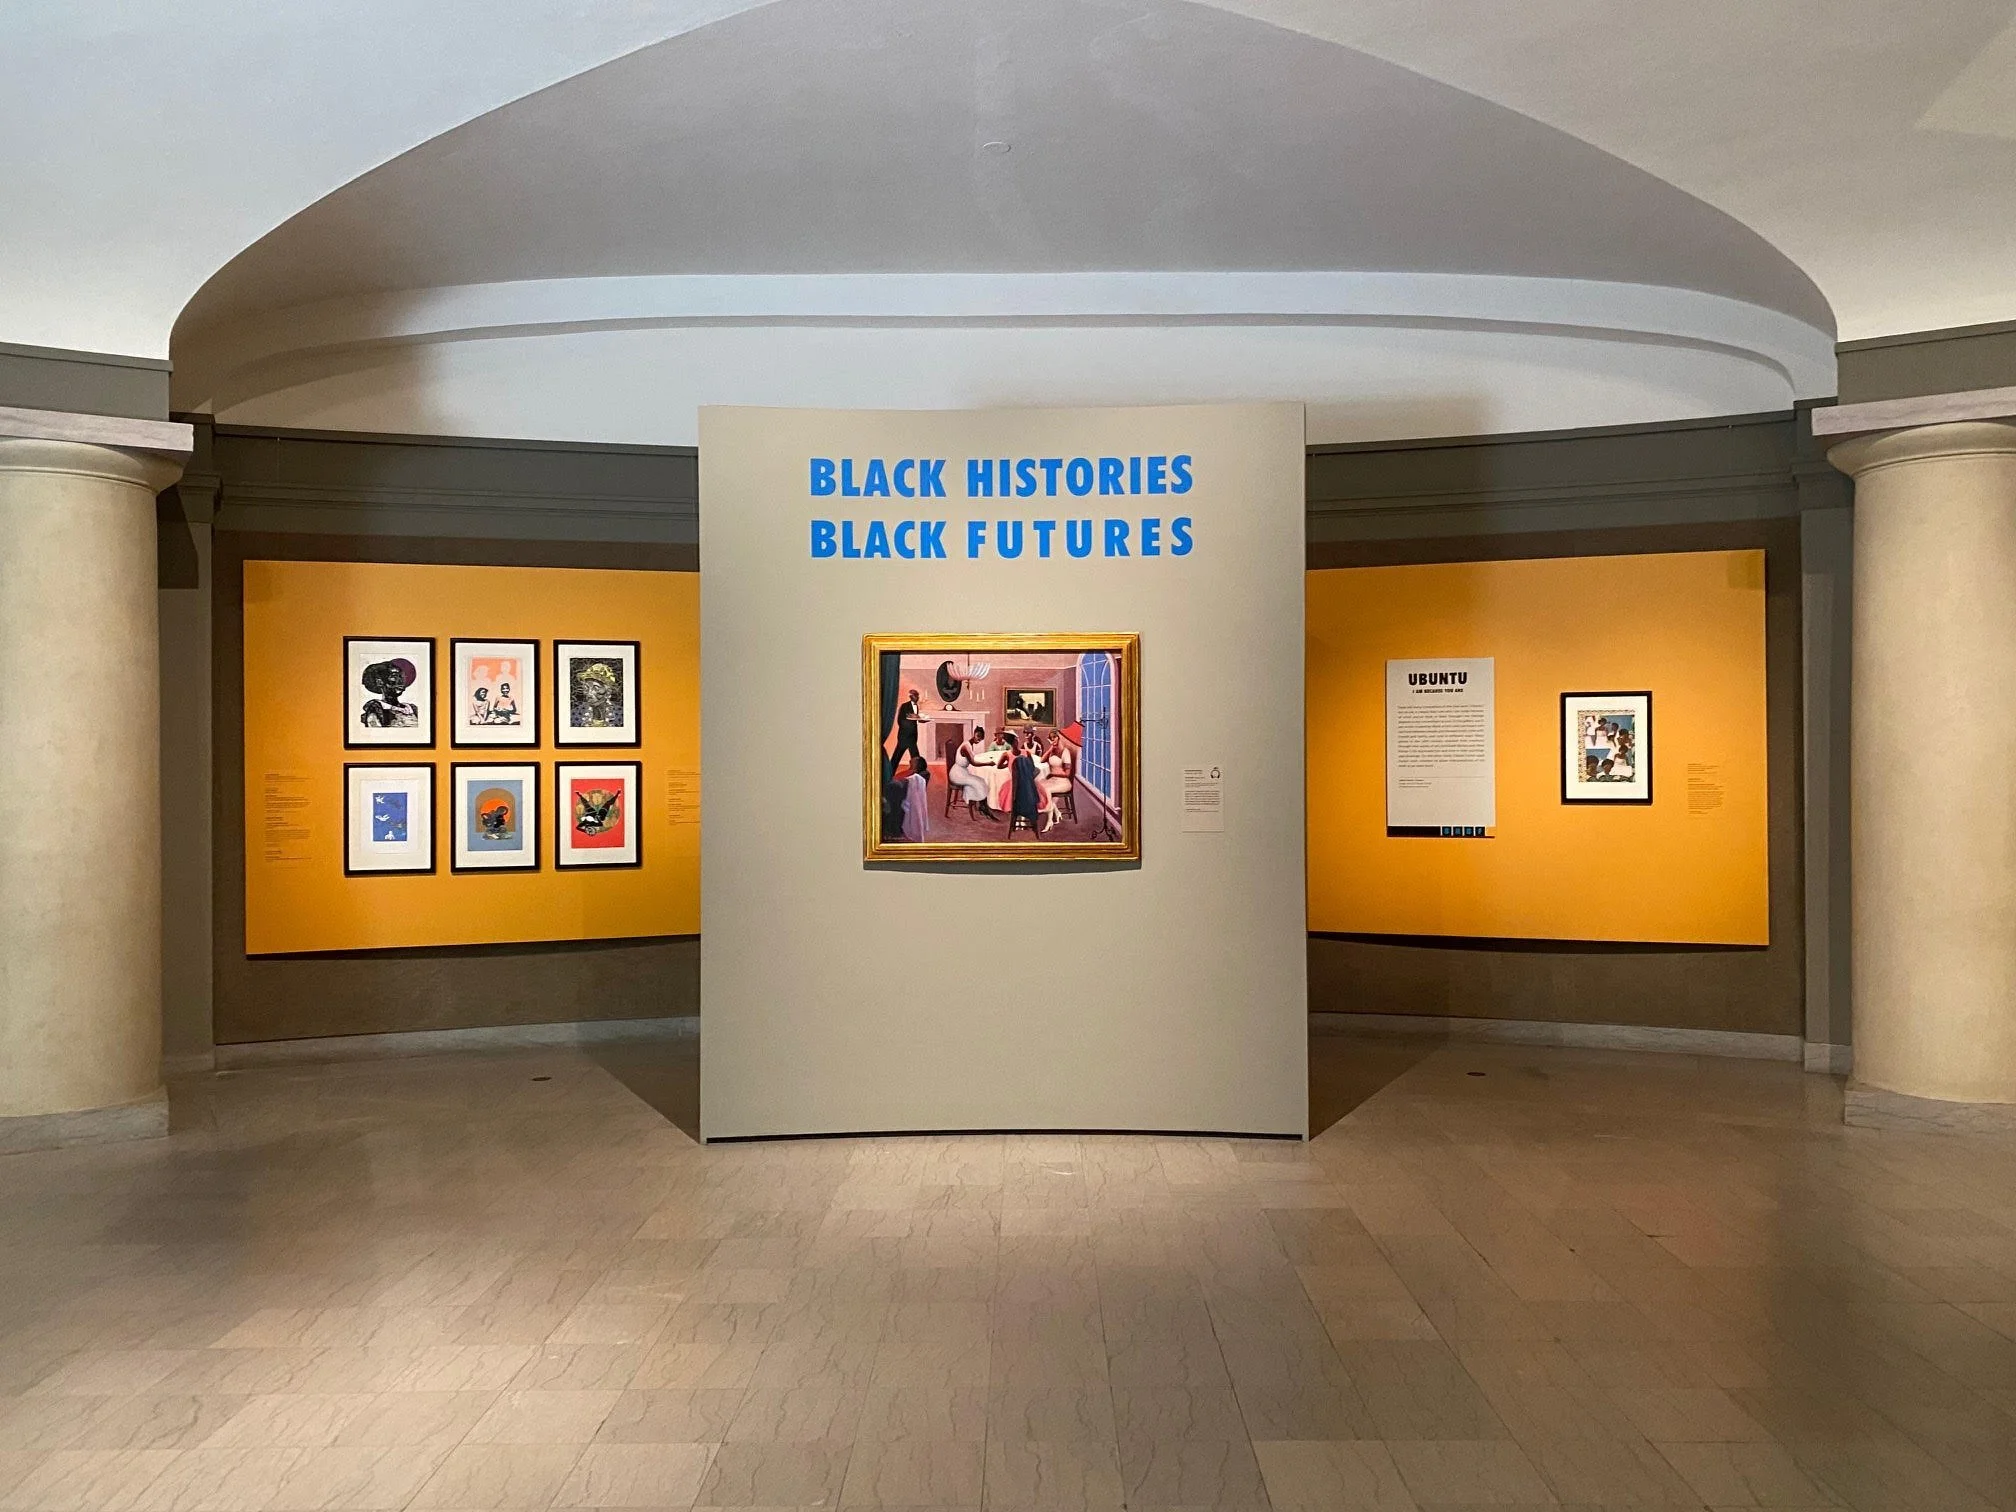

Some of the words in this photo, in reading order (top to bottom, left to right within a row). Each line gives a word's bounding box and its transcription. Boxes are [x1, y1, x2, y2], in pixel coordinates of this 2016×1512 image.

[811, 459, 945, 497] BLACK
[968, 455, 1192, 497] HISTORIES
[812, 521, 945, 558] BLACK
[968, 518, 1192, 558] FUTURES
[1408, 672, 1468, 686] UBUNTU
